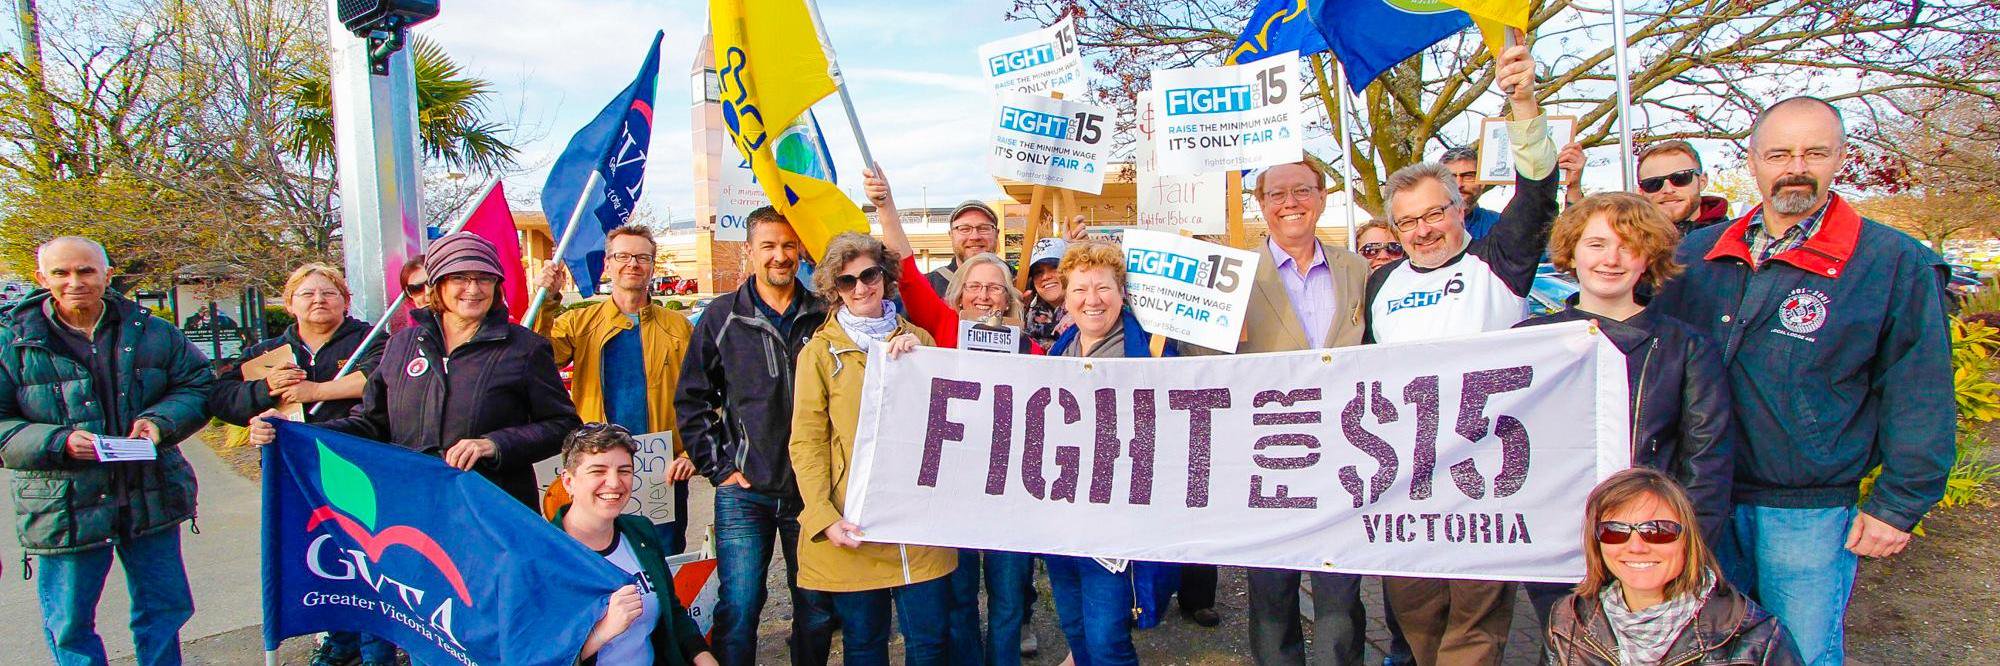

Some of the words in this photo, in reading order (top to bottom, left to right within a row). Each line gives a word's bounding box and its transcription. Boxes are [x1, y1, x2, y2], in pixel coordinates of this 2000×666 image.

[990, 44, 1053, 75] FIGHT
[1055, 24, 1074, 57] 15
[1017, 75, 1031, 84] THE
[1051, 72, 1073, 87] FAIR
[1256, 65, 1288, 107] 15
[1166, 86, 1251, 115] FIGHT
[1252, 83, 1261, 109] FOR
[1000, 107, 1068, 138] FIGHT
[1066, 119, 1078, 140] FOR
[1075, 112, 1104, 145] 15
[1168, 124, 1198, 134] RAISE
[1199, 123, 1218, 132] THE
[1220, 120, 1261, 131] MINIMUM
[1262, 113, 1288, 125] WAGE
[996, 135, 1017, 146] RAISE
[1020, 140, 1037, 150] THE
[1037, 142, 1070, 155] MINIMUM
[1072, 150, 1097, 160] WAGE
[1169, 137, 1197, 150] IT'S
[1200, 134, 1240, 149] ONLY
[1243, 129, 1273, 146] FAIR
[994, 146, 1013, 159] IT'S
[1016, 151, 1051, 166] ONLY
[1051, 156, 1079, 170] FAIR
[1127, 249, 1199, 283] FIGHT
[1195, 260, 1211, 288] FOR
[1207, 254, 1243, 293] 15
[1140, 297, 1173, 312] ONLY
[1175, 303, 1211, 323] FAIR
[1142, 284, 1156, 293] THE
[1157, 286, 1200, 303] MINIMUM
[1203, 298, 1232, 312] WAGE
[968, 329, 992, 344] FIGHT
[999, 333, 1012, 346] $15
[917, 376, 1231, 508] FIGHT
[1248, 387, 1323, 509] FOR
[1338, 365, 1534, 509] $15
[643, 437, 667, 473] 55
[1362, 512, 1533, 545] VICTORIA
[303, 591, 376, 611] Greater
[379, 601, 434, 641] Victoria
